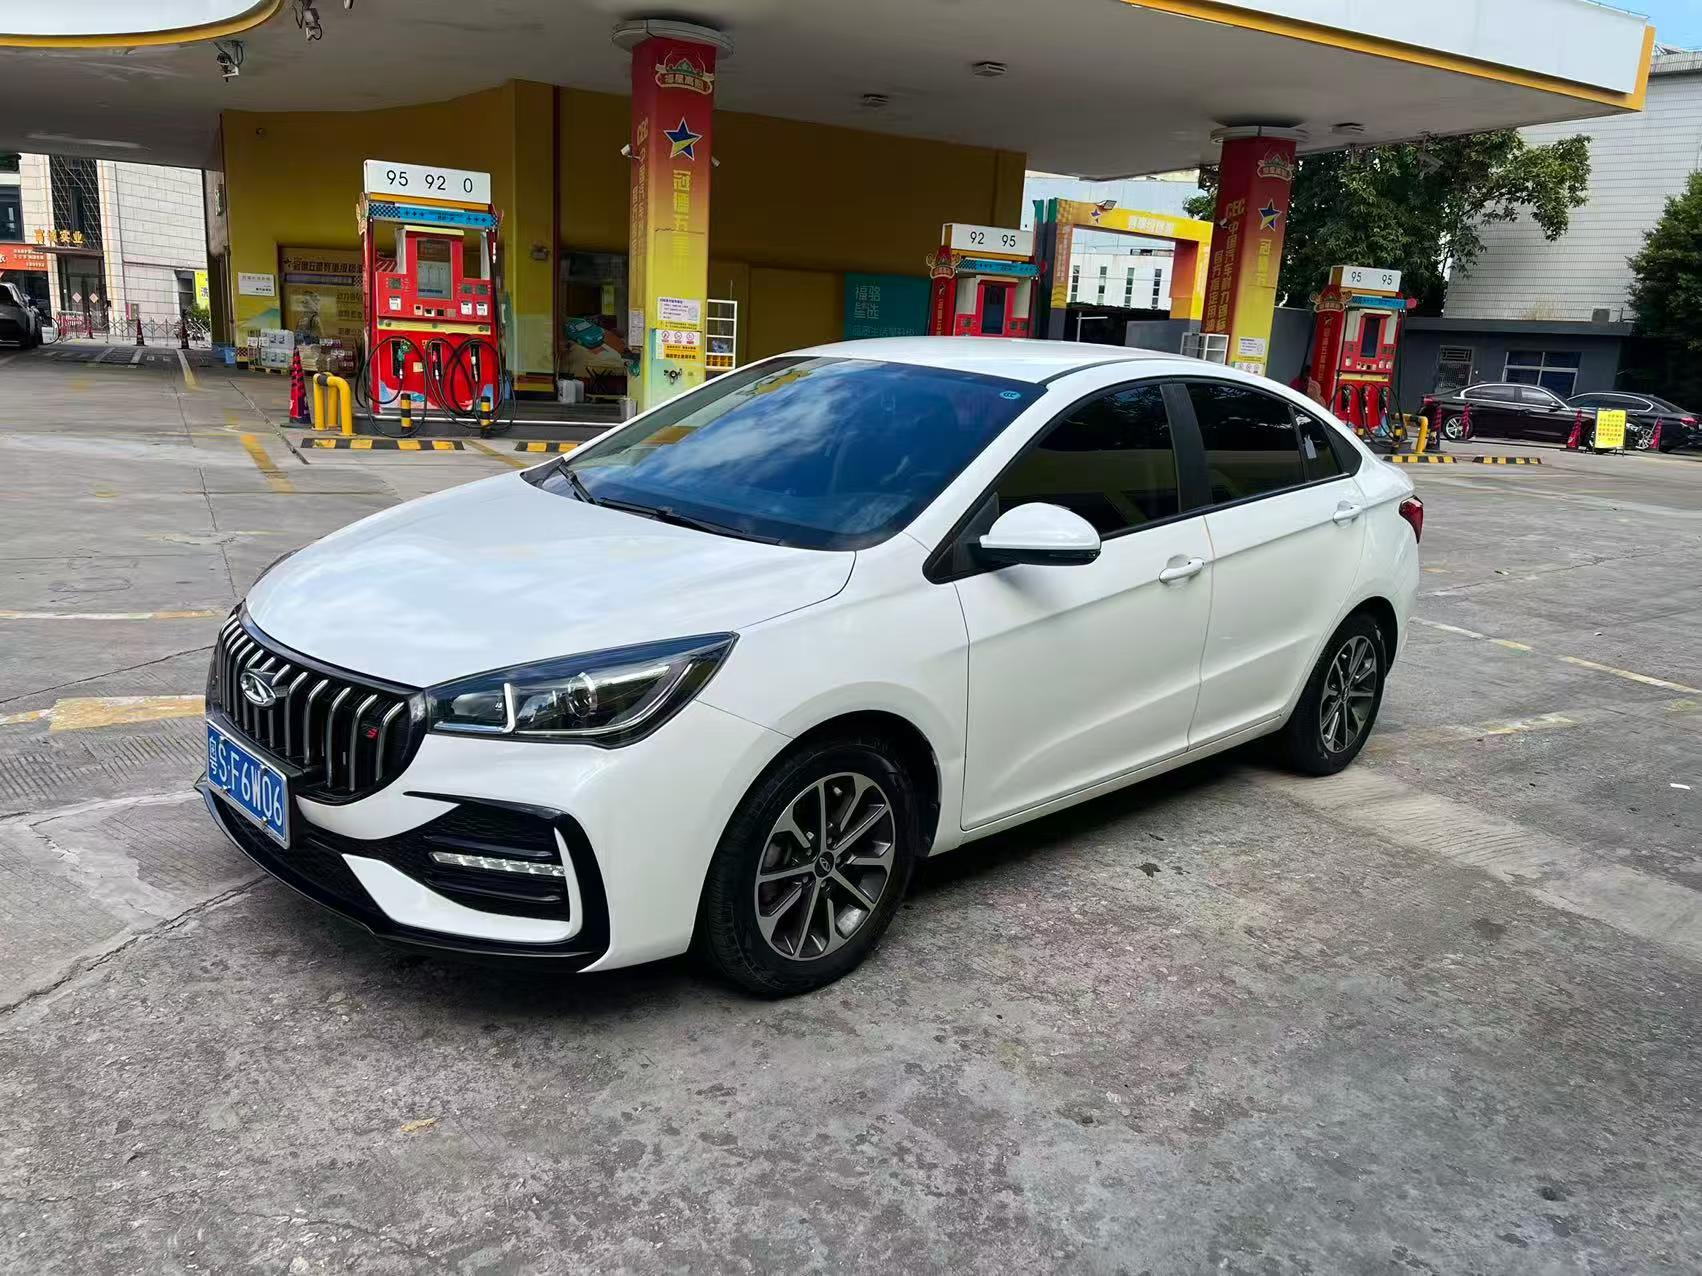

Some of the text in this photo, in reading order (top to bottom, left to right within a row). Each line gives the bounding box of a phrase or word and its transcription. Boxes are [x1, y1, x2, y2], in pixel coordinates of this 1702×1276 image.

[386, 169, 473, 193] 95 92 0
[970, 231, 1016, 247] 92 95
[1351, 271, 1392, 286] 95 95
